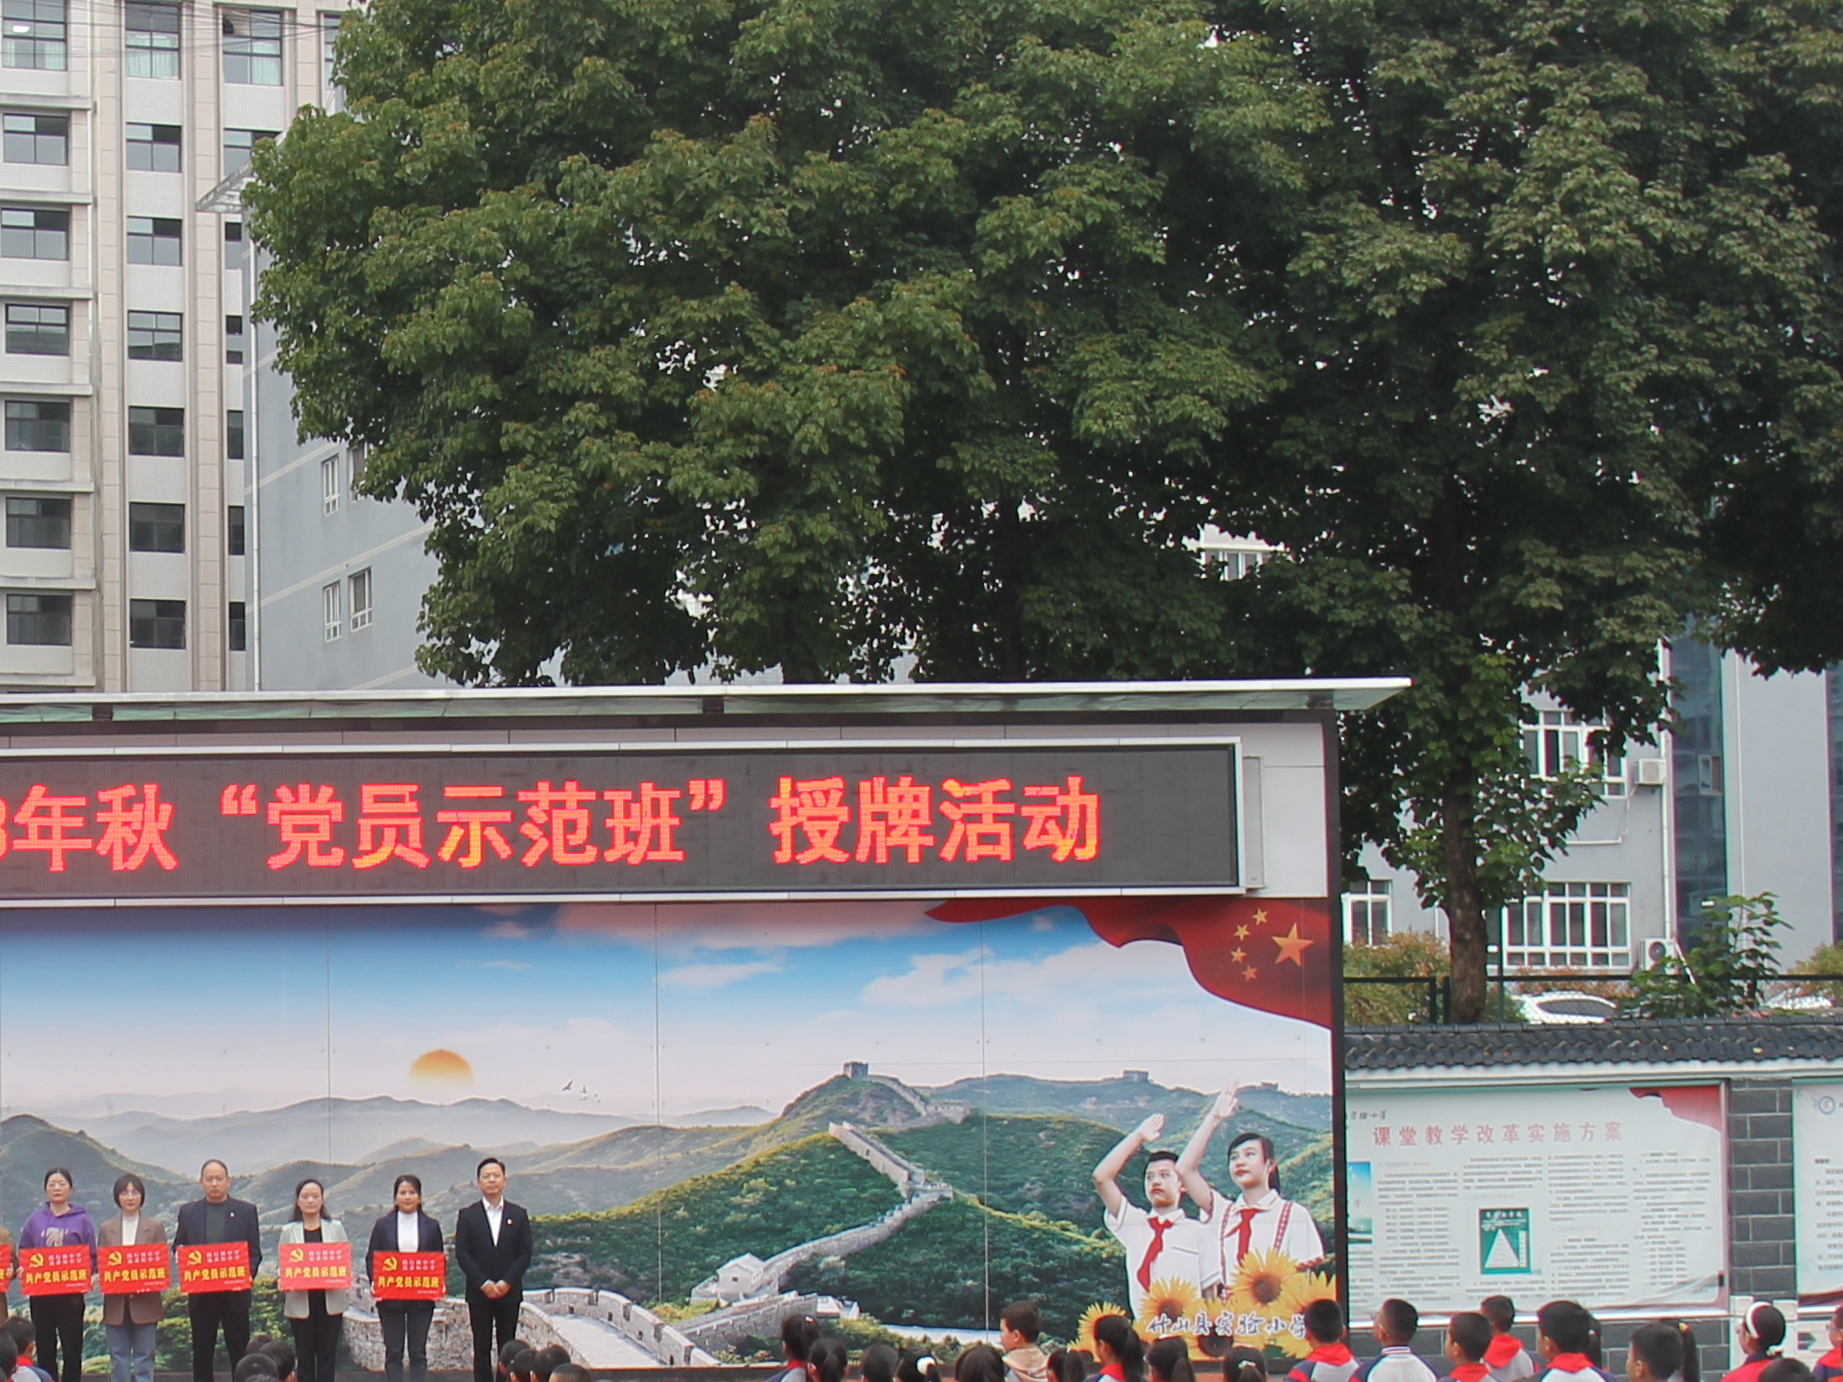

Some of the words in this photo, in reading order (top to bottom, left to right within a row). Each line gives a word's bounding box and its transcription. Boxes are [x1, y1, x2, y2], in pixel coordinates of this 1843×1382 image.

[1372, 1121, 1623, 1146] 课堂教学改革实施方案
